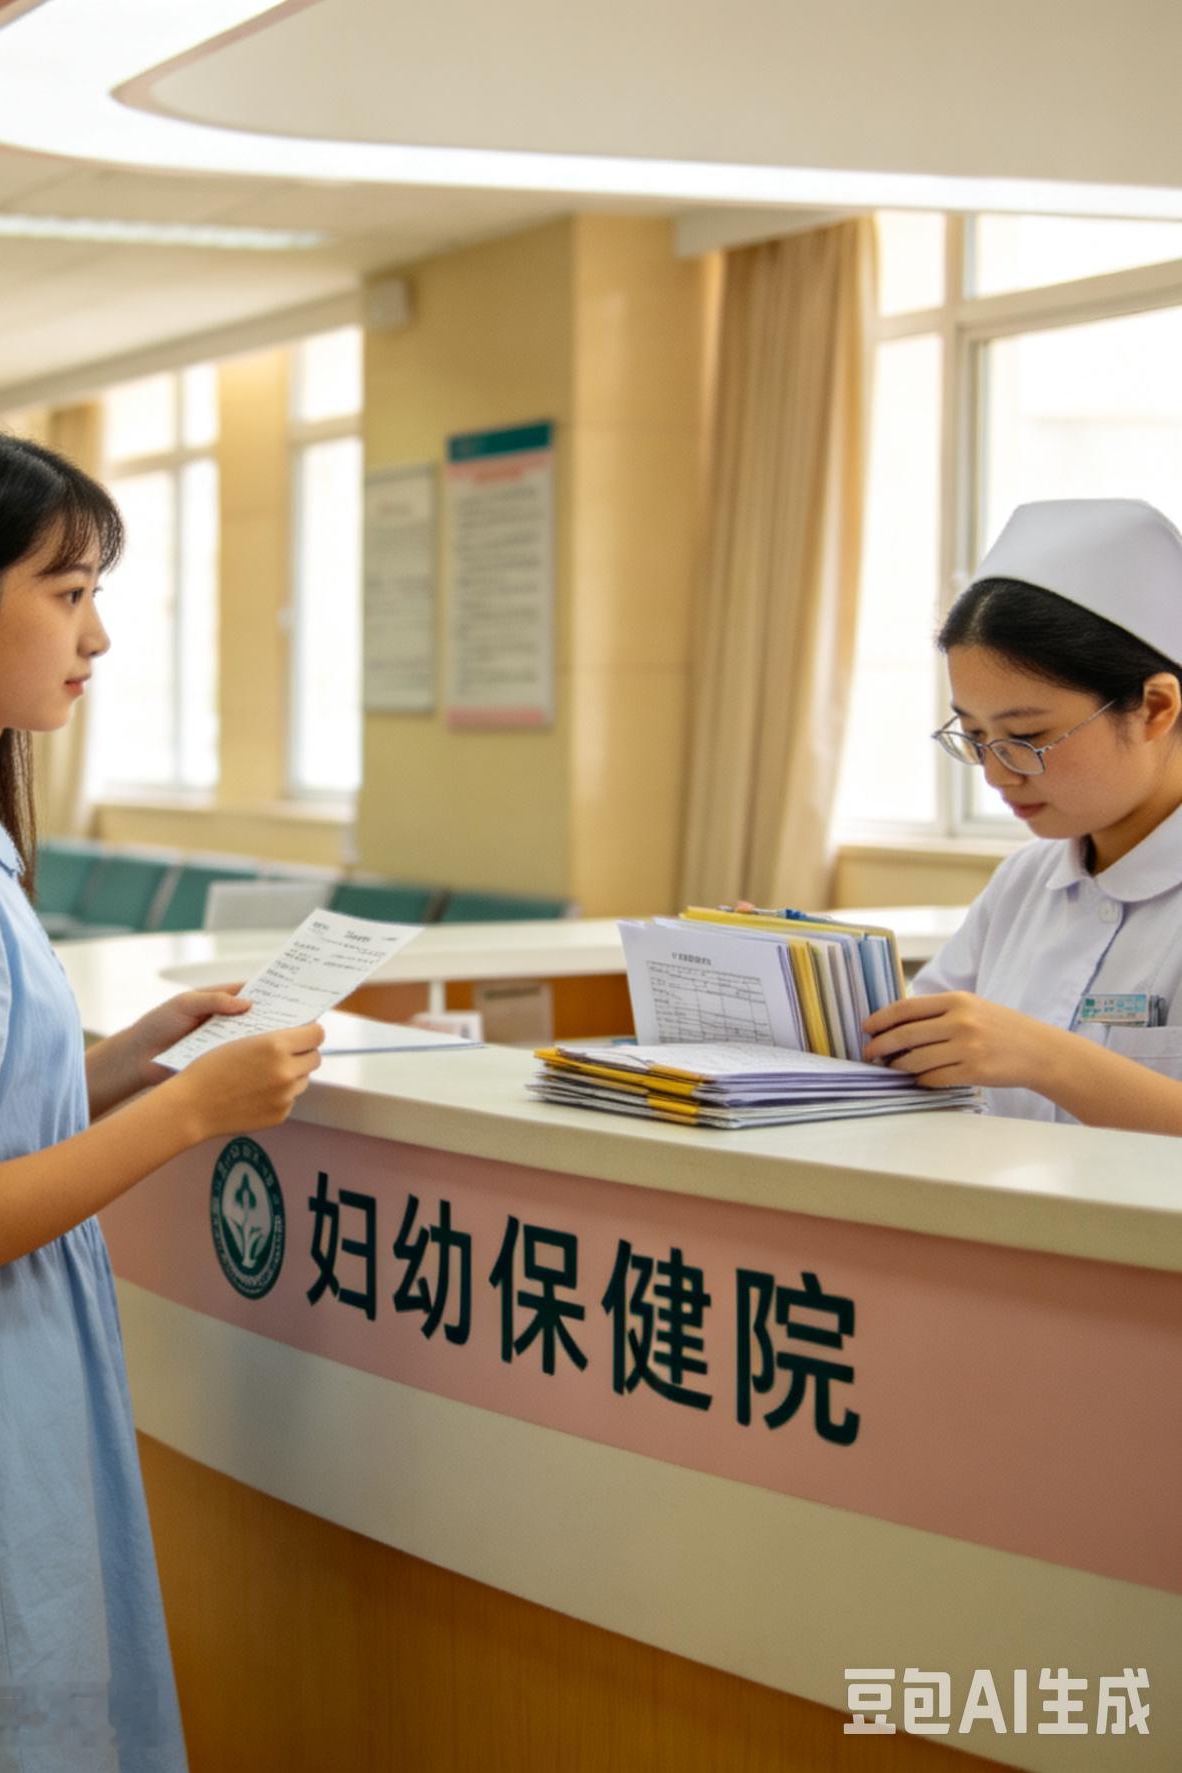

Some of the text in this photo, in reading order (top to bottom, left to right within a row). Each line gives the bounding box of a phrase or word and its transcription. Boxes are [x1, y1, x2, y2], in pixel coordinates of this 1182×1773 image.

[305, 1171, 861, 1447] 妇幼保健院
